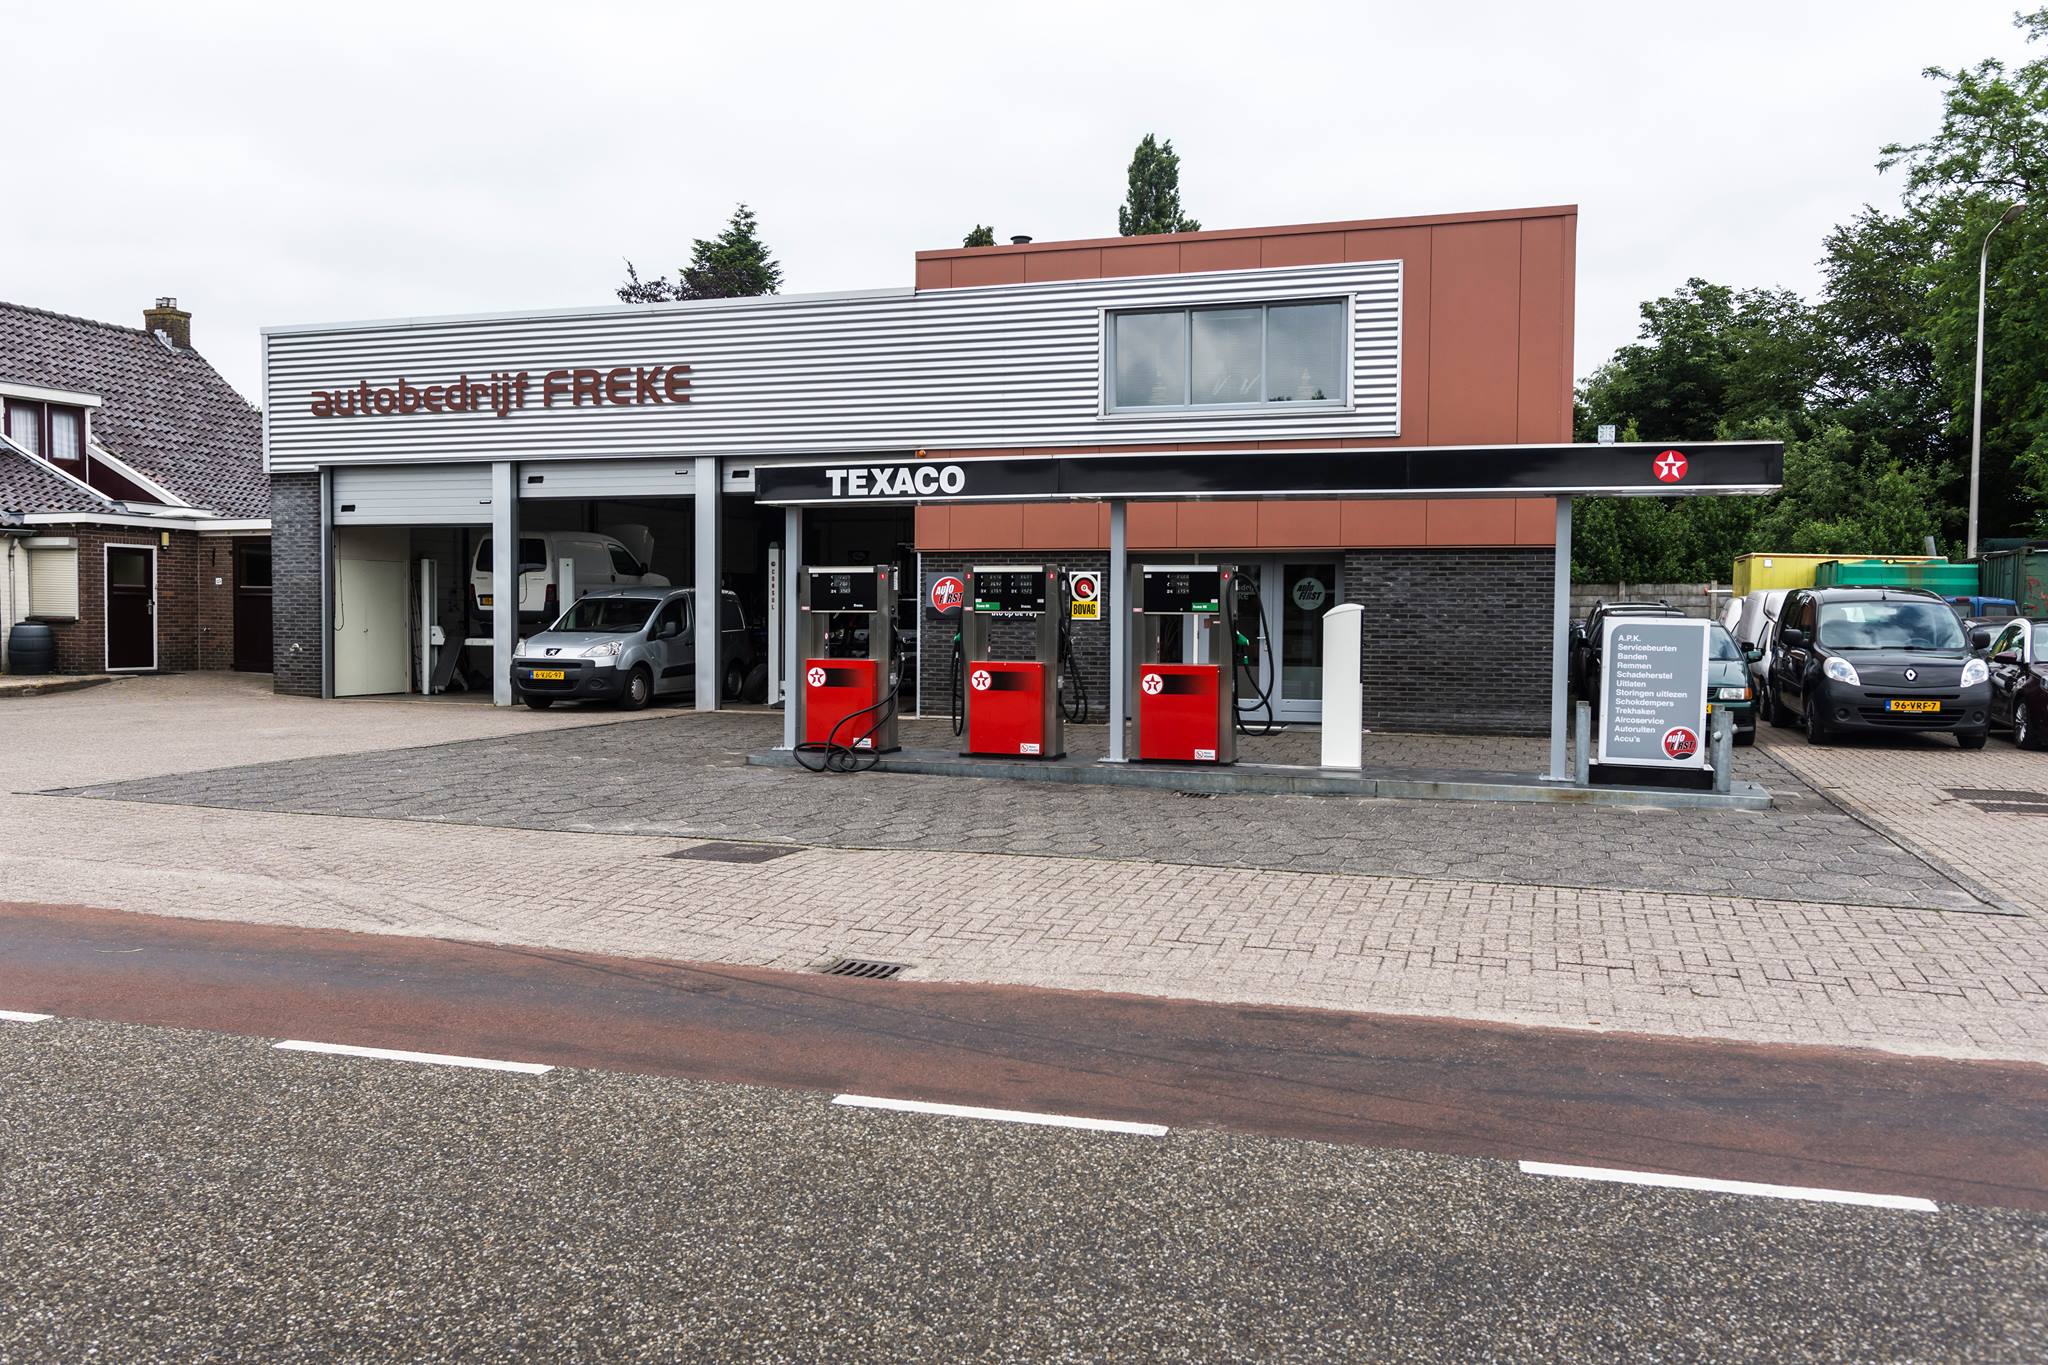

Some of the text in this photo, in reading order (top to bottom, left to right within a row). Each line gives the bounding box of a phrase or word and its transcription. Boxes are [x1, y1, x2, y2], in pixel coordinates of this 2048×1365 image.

[311, 365, 691, 417] autobedrijf FREKE
[825, 465, 966, 496] TEXACO
[1299, 591, 1322, 601] FIRST
[1073, 604, 1096, 615] BOVAG
[1618, 634, 1641, 642] A.P.K.
[1617, 643, 1677, 652] Servicebeurten
[1617, 652, 1648, 661] Banden
[1617, 661, 1652, 670] Remmen
[1616, 670, 1673, 680] Schadeherstel
[1616, 680, 1647, 688] Uitlaten
[1615, 689, 1688, 698] Storingen uitlezen
[1615, 698, 1675, 708] Schokdempers
[1894, 701, 1937, 709] 96-VRF-7
[1615, 707, 1656, 715] Trekhaken
[1614, 716, 1665, 725] Aircoservice
[1614, 725, 1656, 733] Autoruiten
[1614, 735, 1641, 743] Accu's
